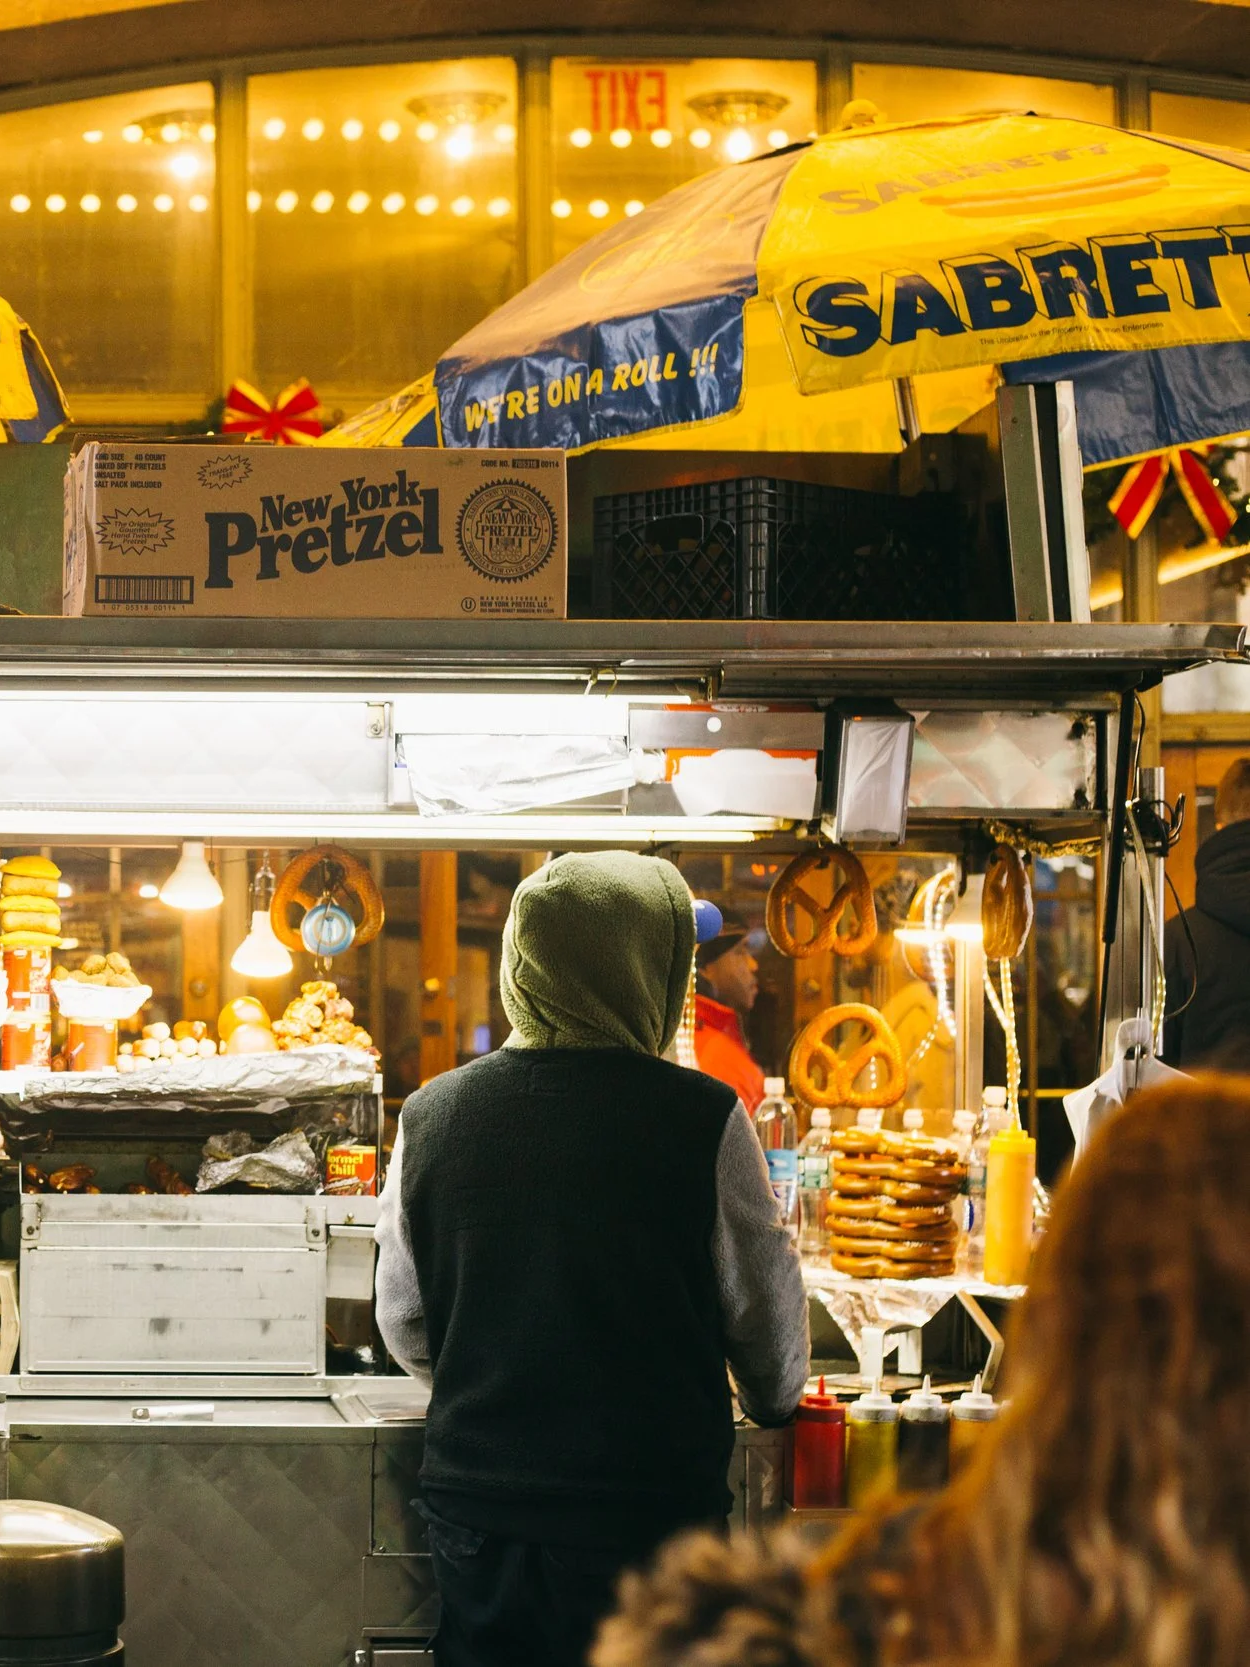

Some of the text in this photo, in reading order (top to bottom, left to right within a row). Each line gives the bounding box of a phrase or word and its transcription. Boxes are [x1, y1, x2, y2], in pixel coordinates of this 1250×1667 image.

[1039, 329, 1051, 337] the
[1122, 322, 1164, 333] Enterprises
[464, 343, 719, 432] WE'RE ON A ROLL !!!
[111, 453, 124, 461] SIZE
[95, 462, 115, 470] BAKED
[117, 462, 133, 470] SOFT
[481, 460, 497, 468] CODE
[95, 471, 125, 479] UNSALTED
[94, 480, 108, 488] SALT
[111, 480, 128, 488] PACK
[260, 494, 332, 533] New
[340, 469, 422, 516] York
[484, 513, 533, 525] NEW YORK
[481, 525, 536, 537] PRETZEL
[204, 488, 443, 589] Pretzel
[329, 1163, 356, 1175] Chili
